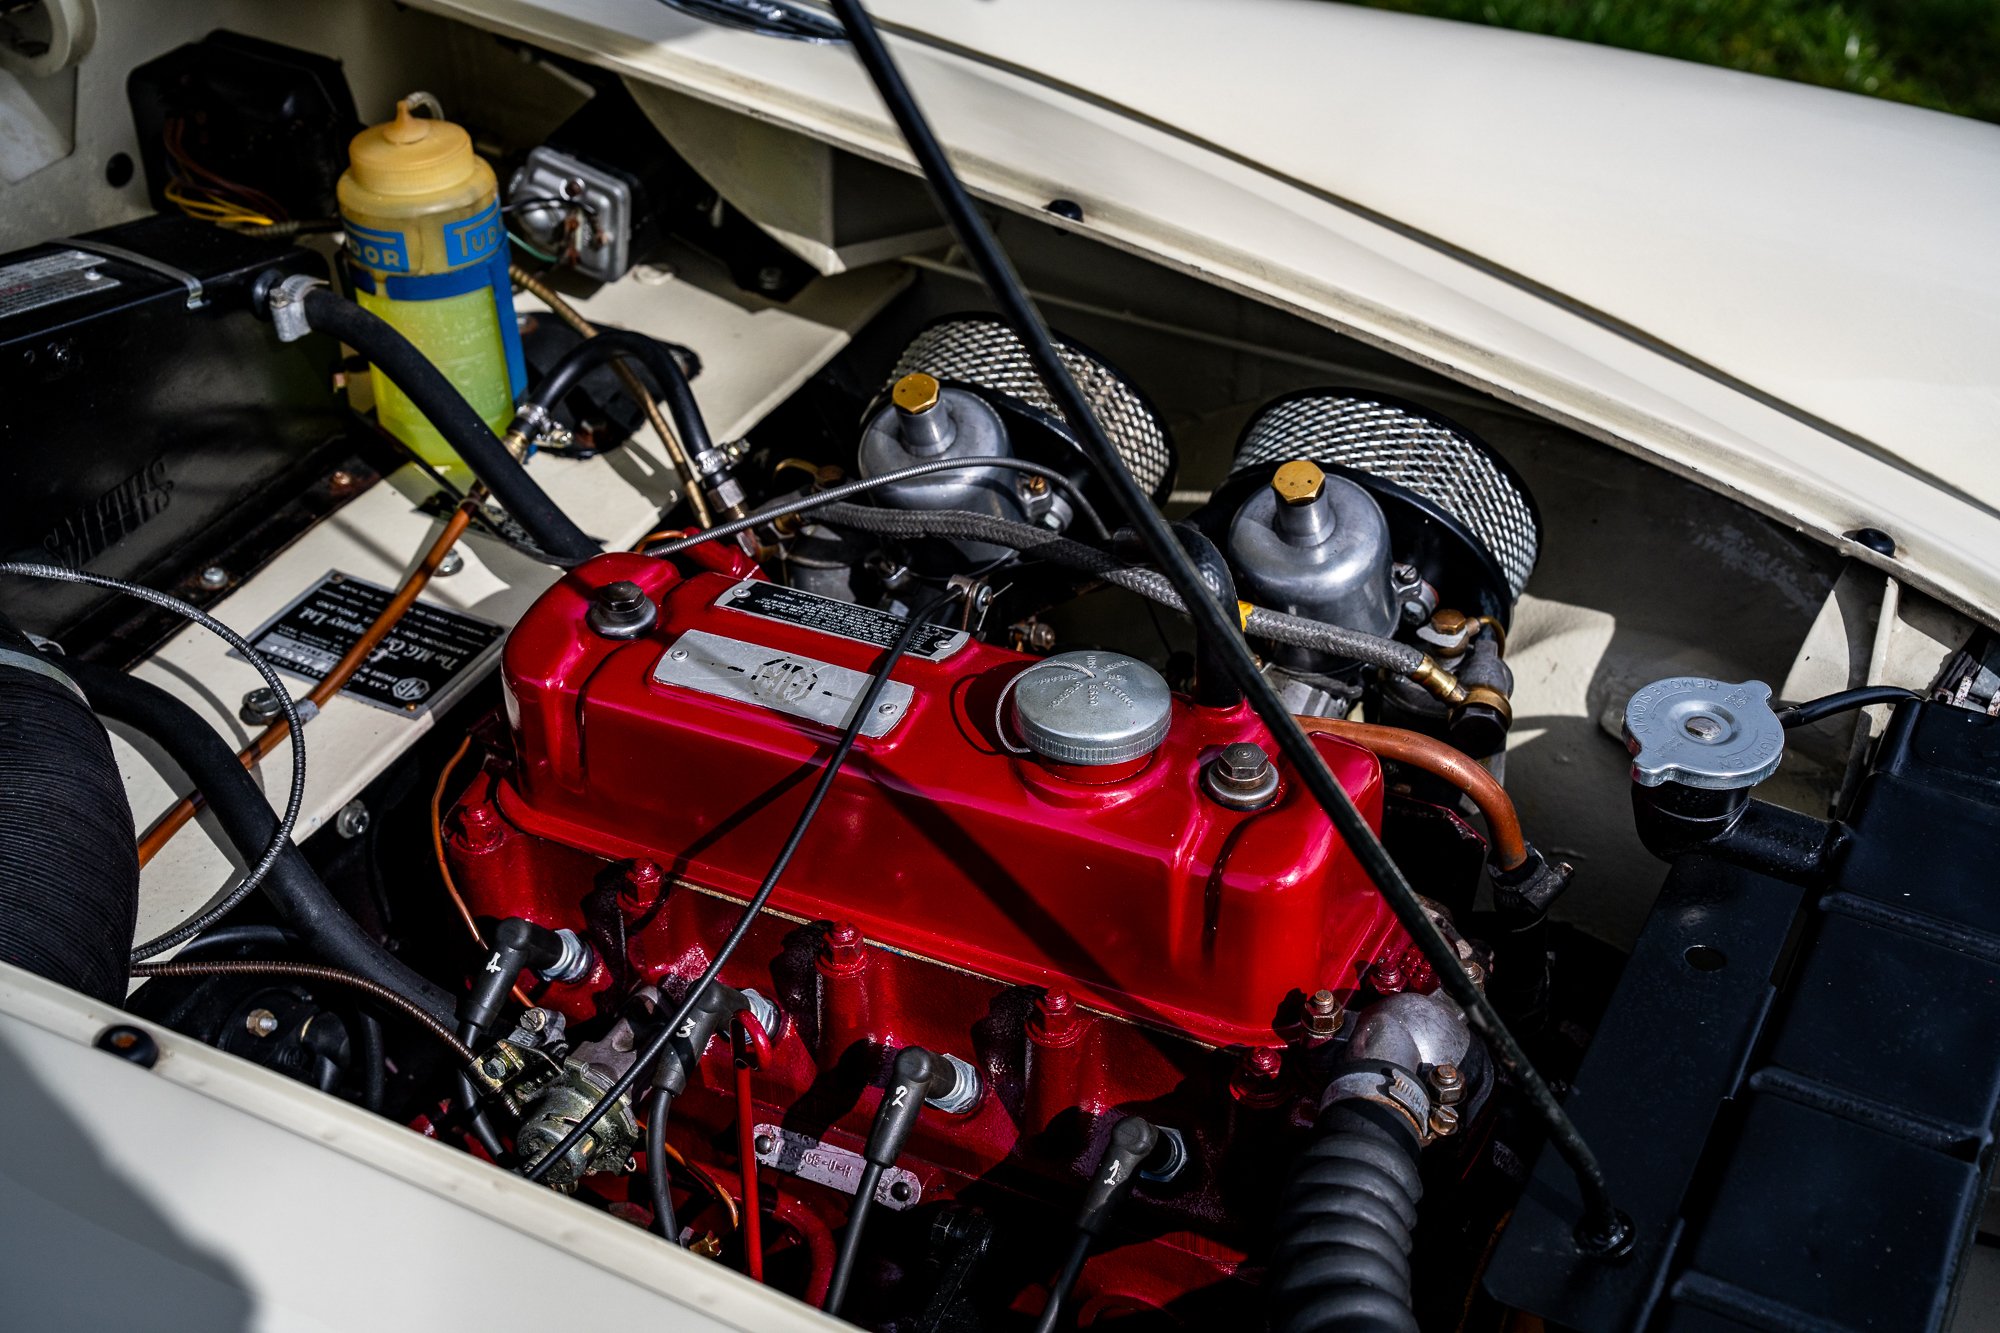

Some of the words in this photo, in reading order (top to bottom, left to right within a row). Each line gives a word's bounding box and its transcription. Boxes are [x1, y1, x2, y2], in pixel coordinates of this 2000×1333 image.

[316, 601, 359, 618] ENGLAND
[435, 654, 458, 670] The
[368, 680, 388, 689] CAR
[394, 678, 429, 700] MG
[1088, 684, 1099, 706] ESSO
[1650, 679, 1719, 696] REMOVE
[1720, 730, 1779, 770] TIGHTEN
[485, 951, 502, 974] 4
[676, 1017, 697, 1038] 3
[892, 1085, 908, 1108] 2
[1104, 1159, 1120, 1185] 1
